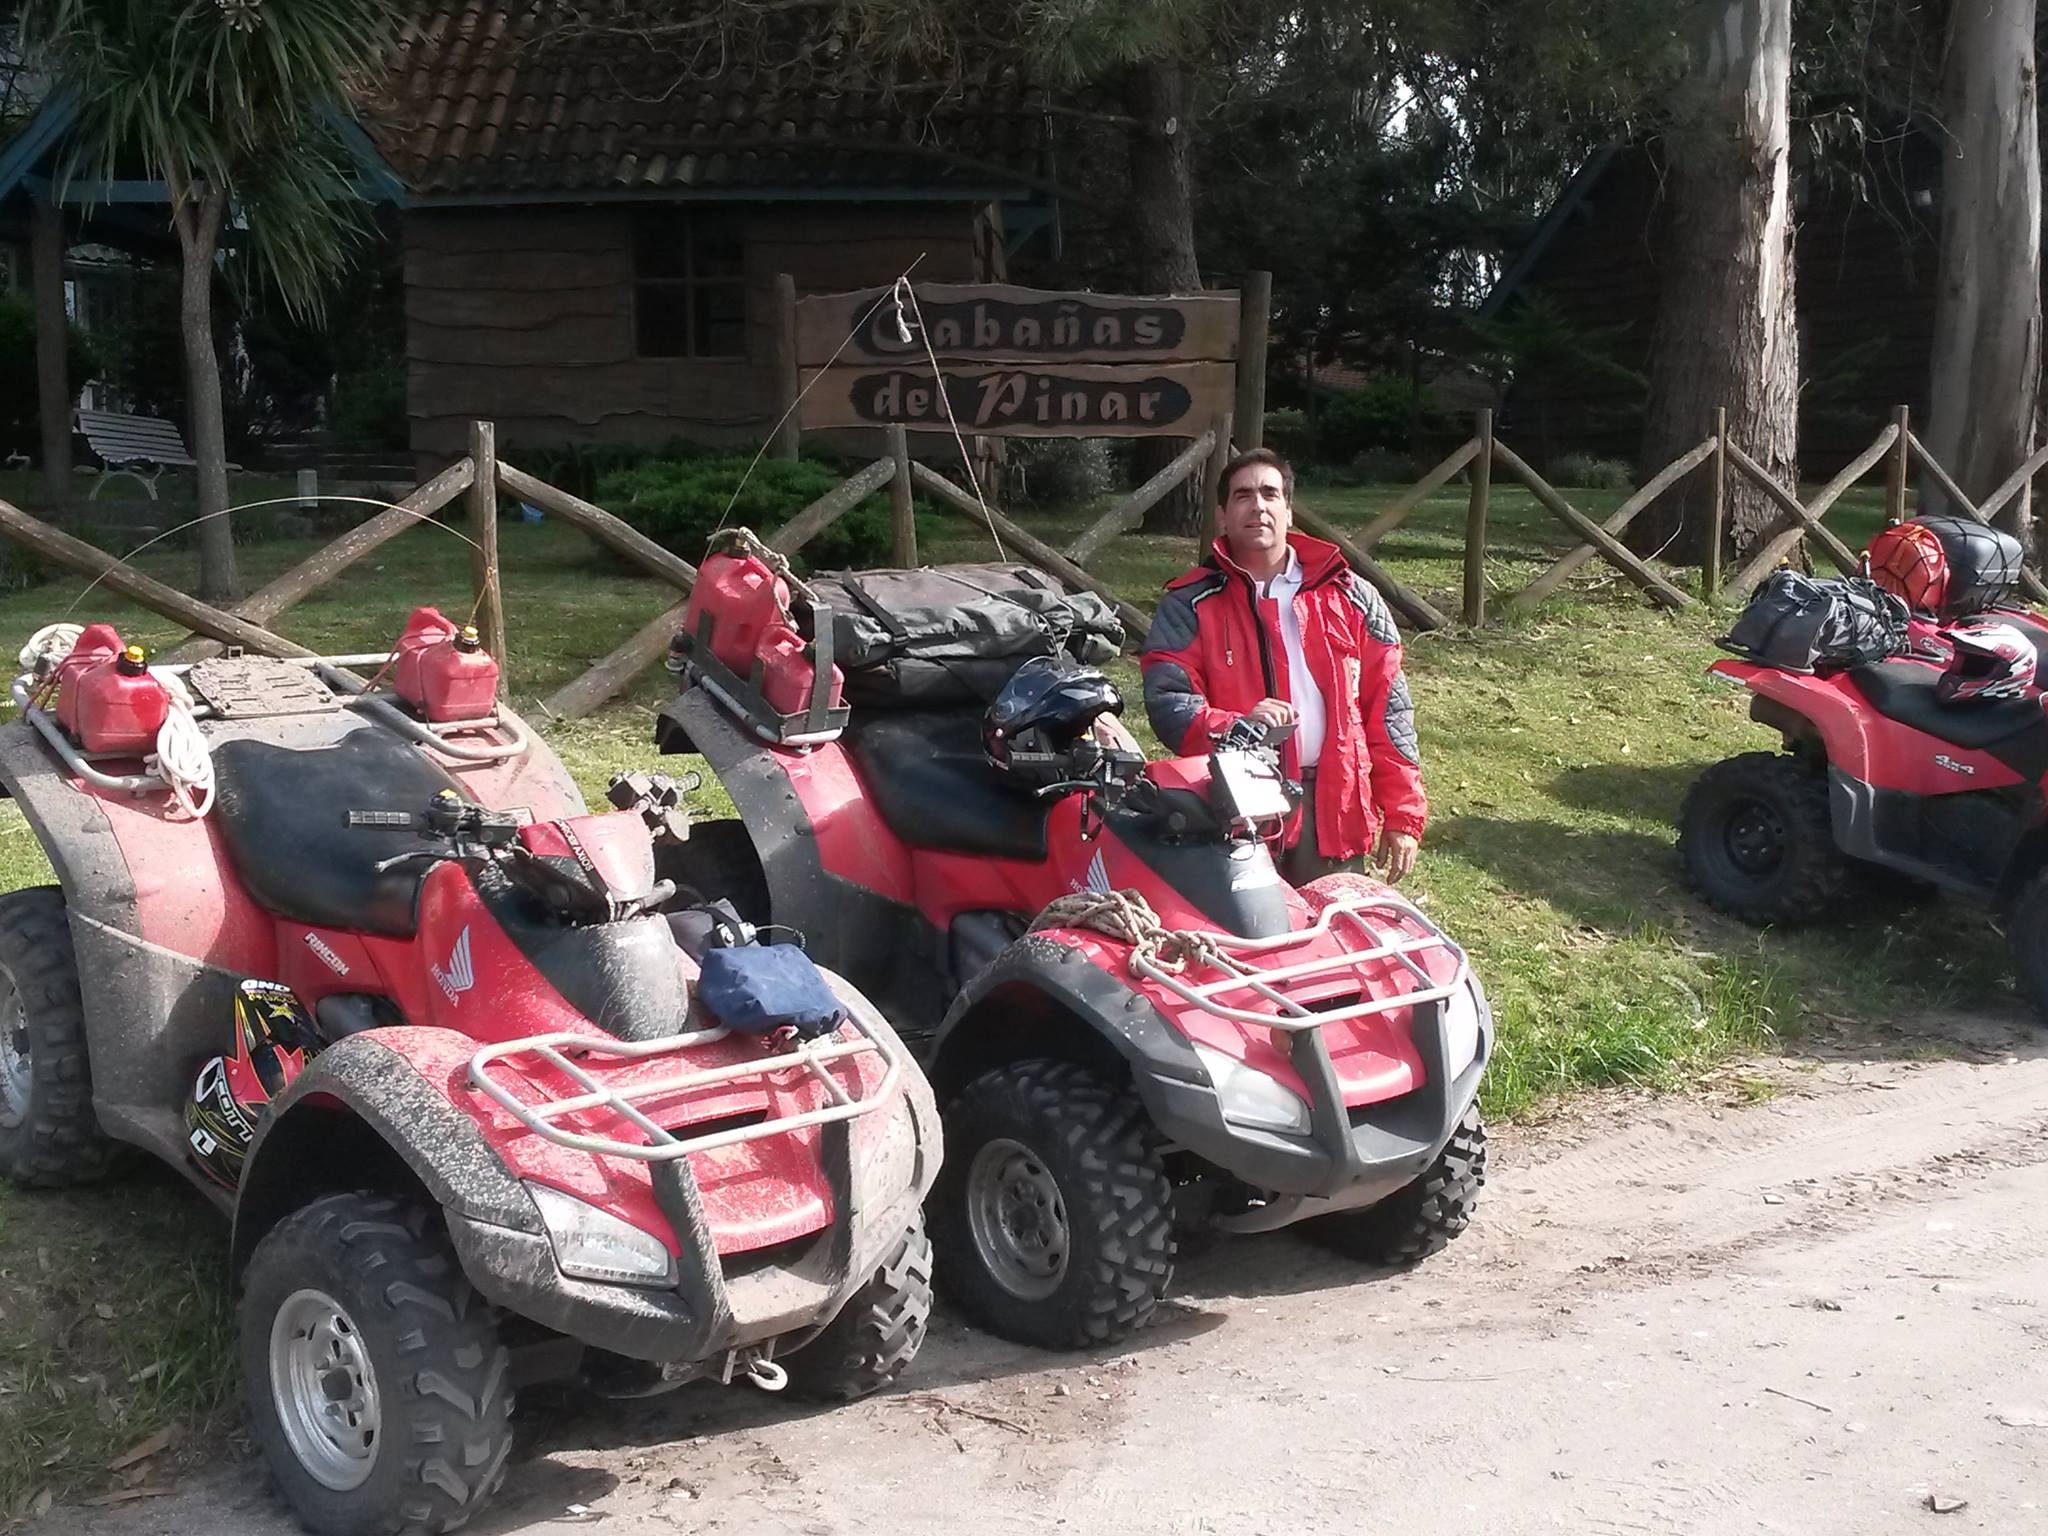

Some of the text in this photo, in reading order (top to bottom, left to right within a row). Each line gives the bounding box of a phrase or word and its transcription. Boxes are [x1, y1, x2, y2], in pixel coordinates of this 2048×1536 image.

[871, 298, 1162, 352] Cabañas
[873, 371, 1161, 426] del Pinar
[304, 931, 351, 976] RINCON
[430, 963, 460, 1009] HONDA
